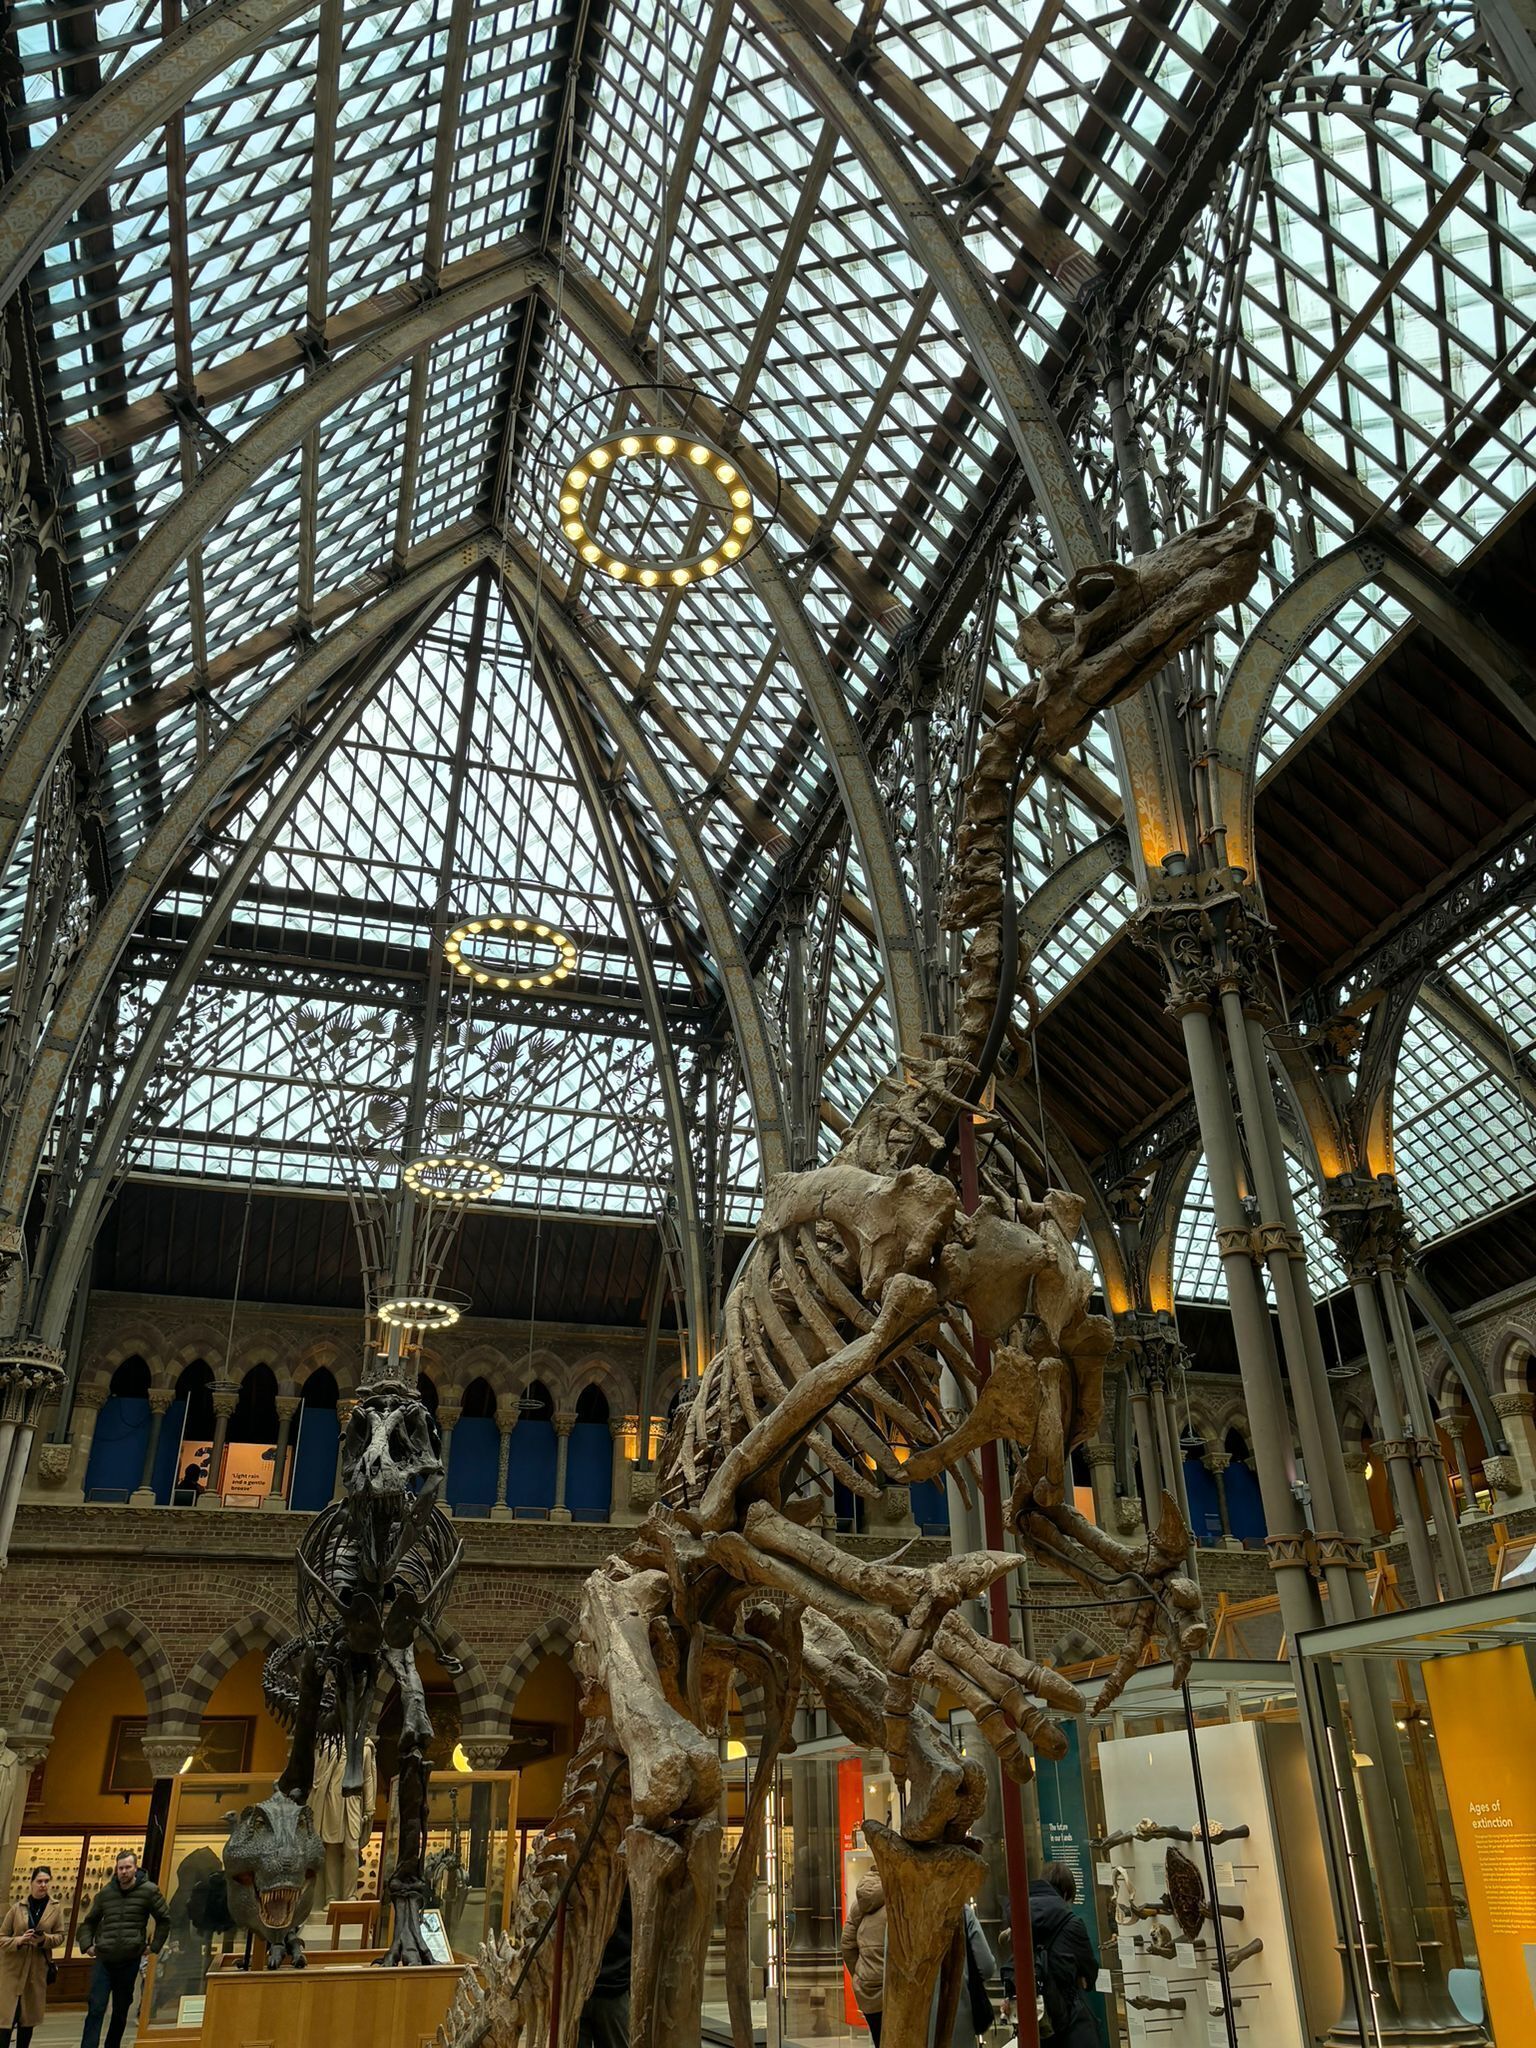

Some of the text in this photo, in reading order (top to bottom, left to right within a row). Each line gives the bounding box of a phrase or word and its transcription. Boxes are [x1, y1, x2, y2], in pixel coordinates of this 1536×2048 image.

[1469, 1799, 1501, 1816] Ages of
[1472, 1816, 1513, 1829] extinction
